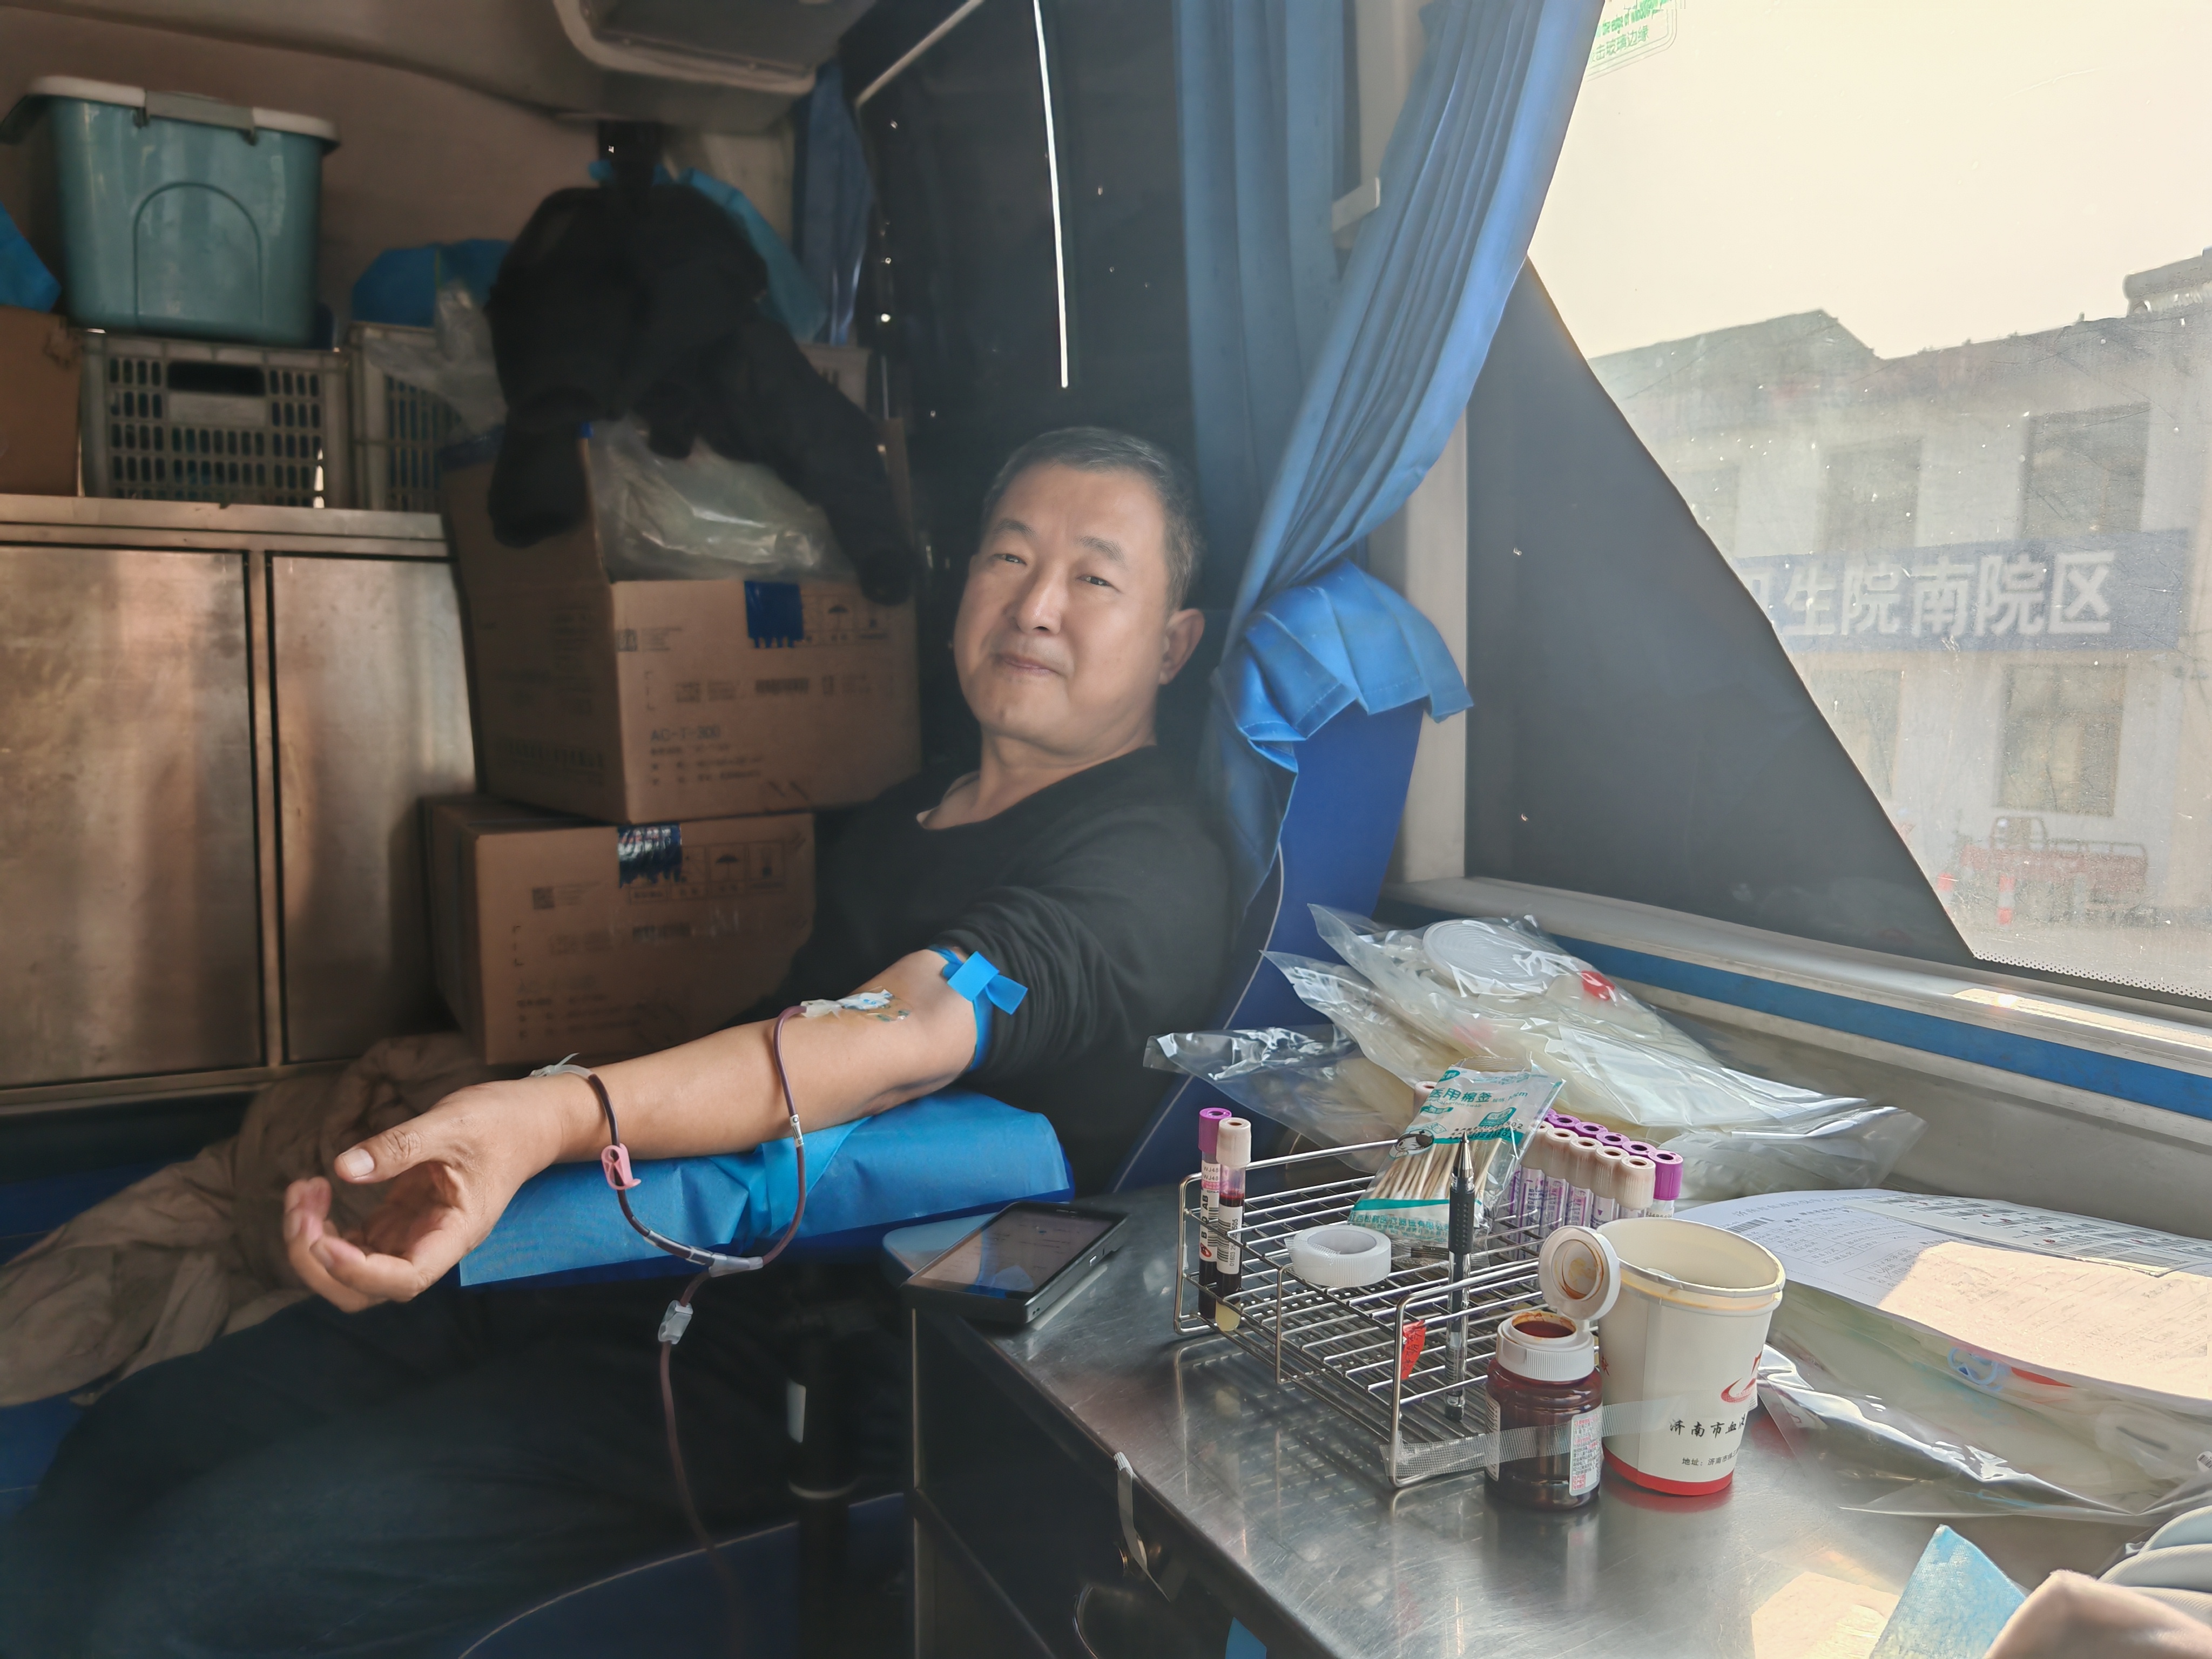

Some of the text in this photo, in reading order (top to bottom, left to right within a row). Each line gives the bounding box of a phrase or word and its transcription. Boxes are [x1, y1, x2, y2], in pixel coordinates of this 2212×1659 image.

[1428, 1087, 1494, 1103] 医用棉签
[1202, 1195, 1209, 1210] AB
